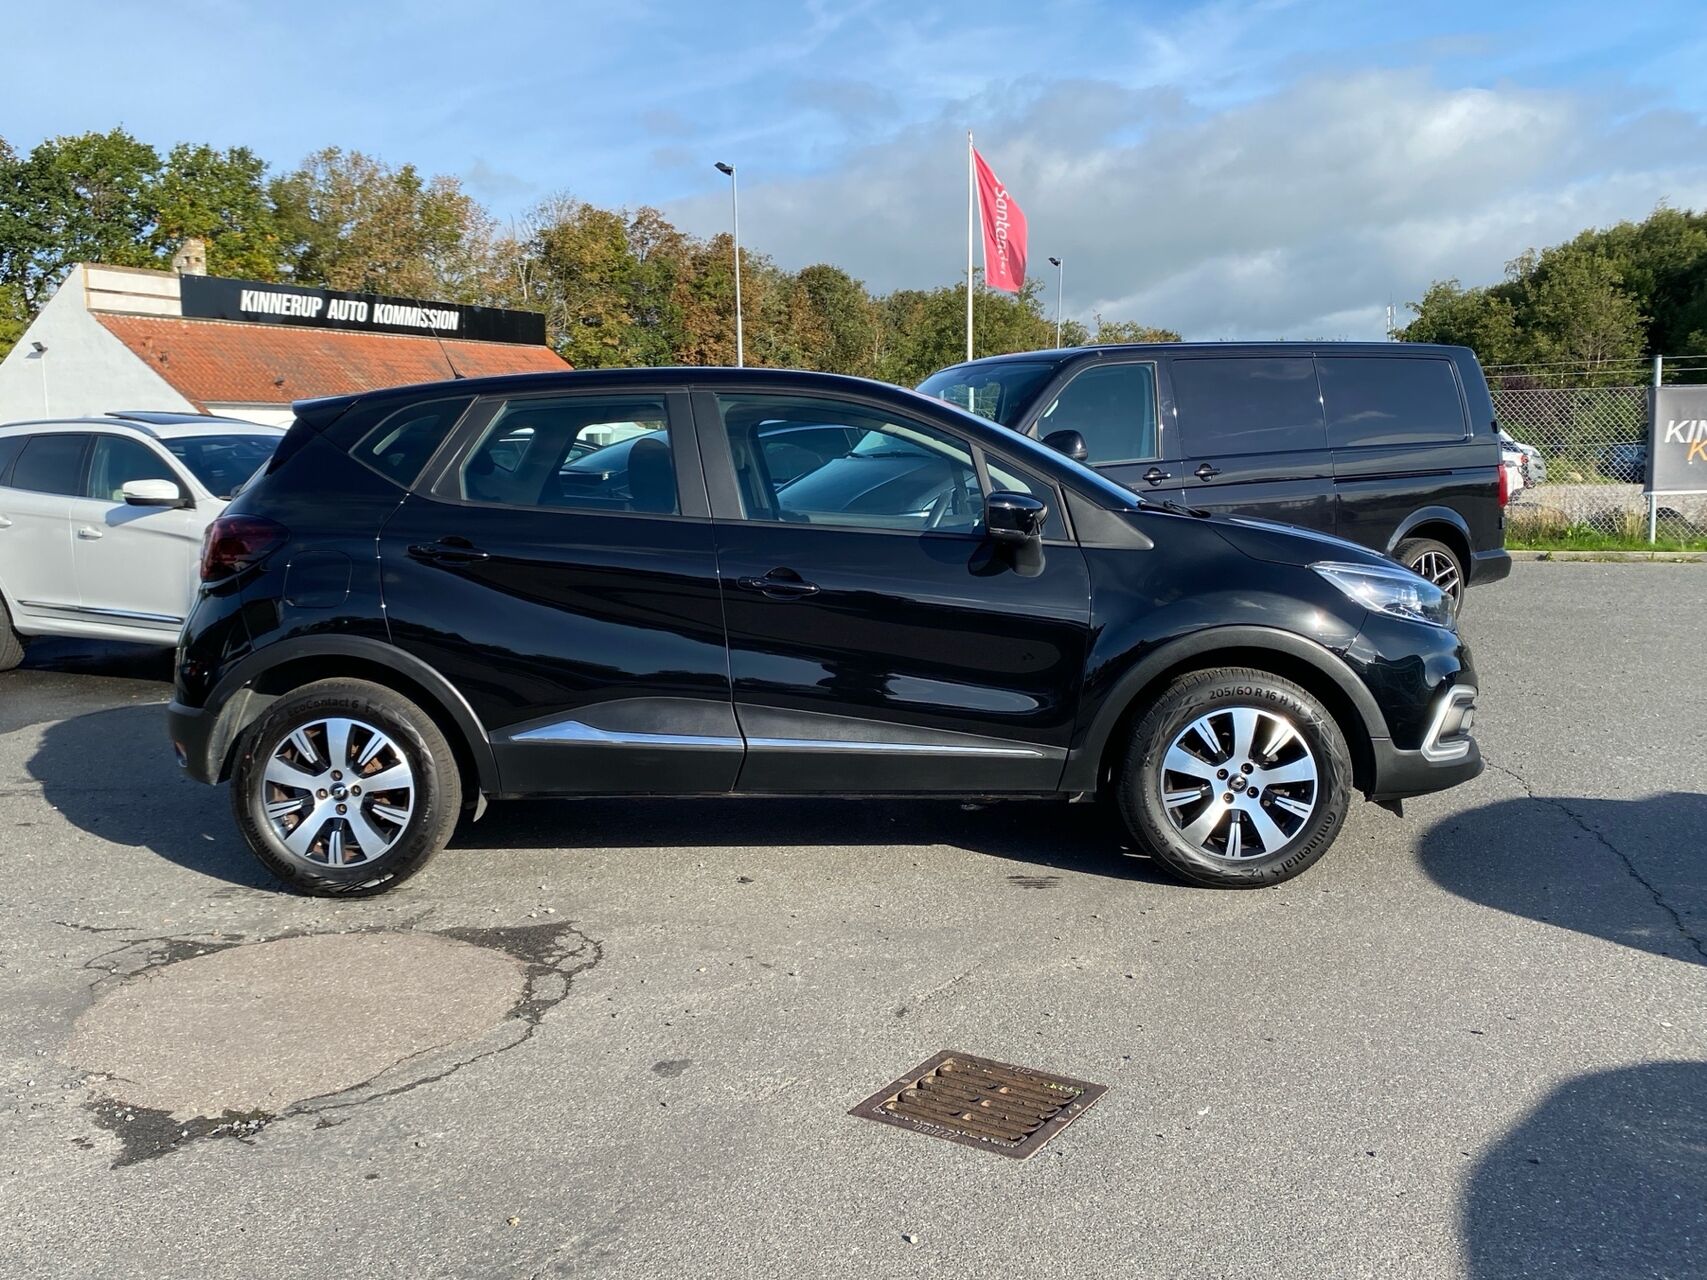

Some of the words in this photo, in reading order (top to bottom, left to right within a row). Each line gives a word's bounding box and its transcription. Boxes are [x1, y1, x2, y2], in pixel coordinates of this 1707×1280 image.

[240, 289, 323, 318] KINNERUP
[327, 298, 368, 323] AUTO
[372, 303, 460, 331] KOMMISSION
[1208, 686, 1252, 700] 205/60
[1254, 687, 1263, 697] R
[1265, 689, 1278, 701] 16
[1279, 695, 1289, 706] H
[1280, 810, 1338, 873] Continental
